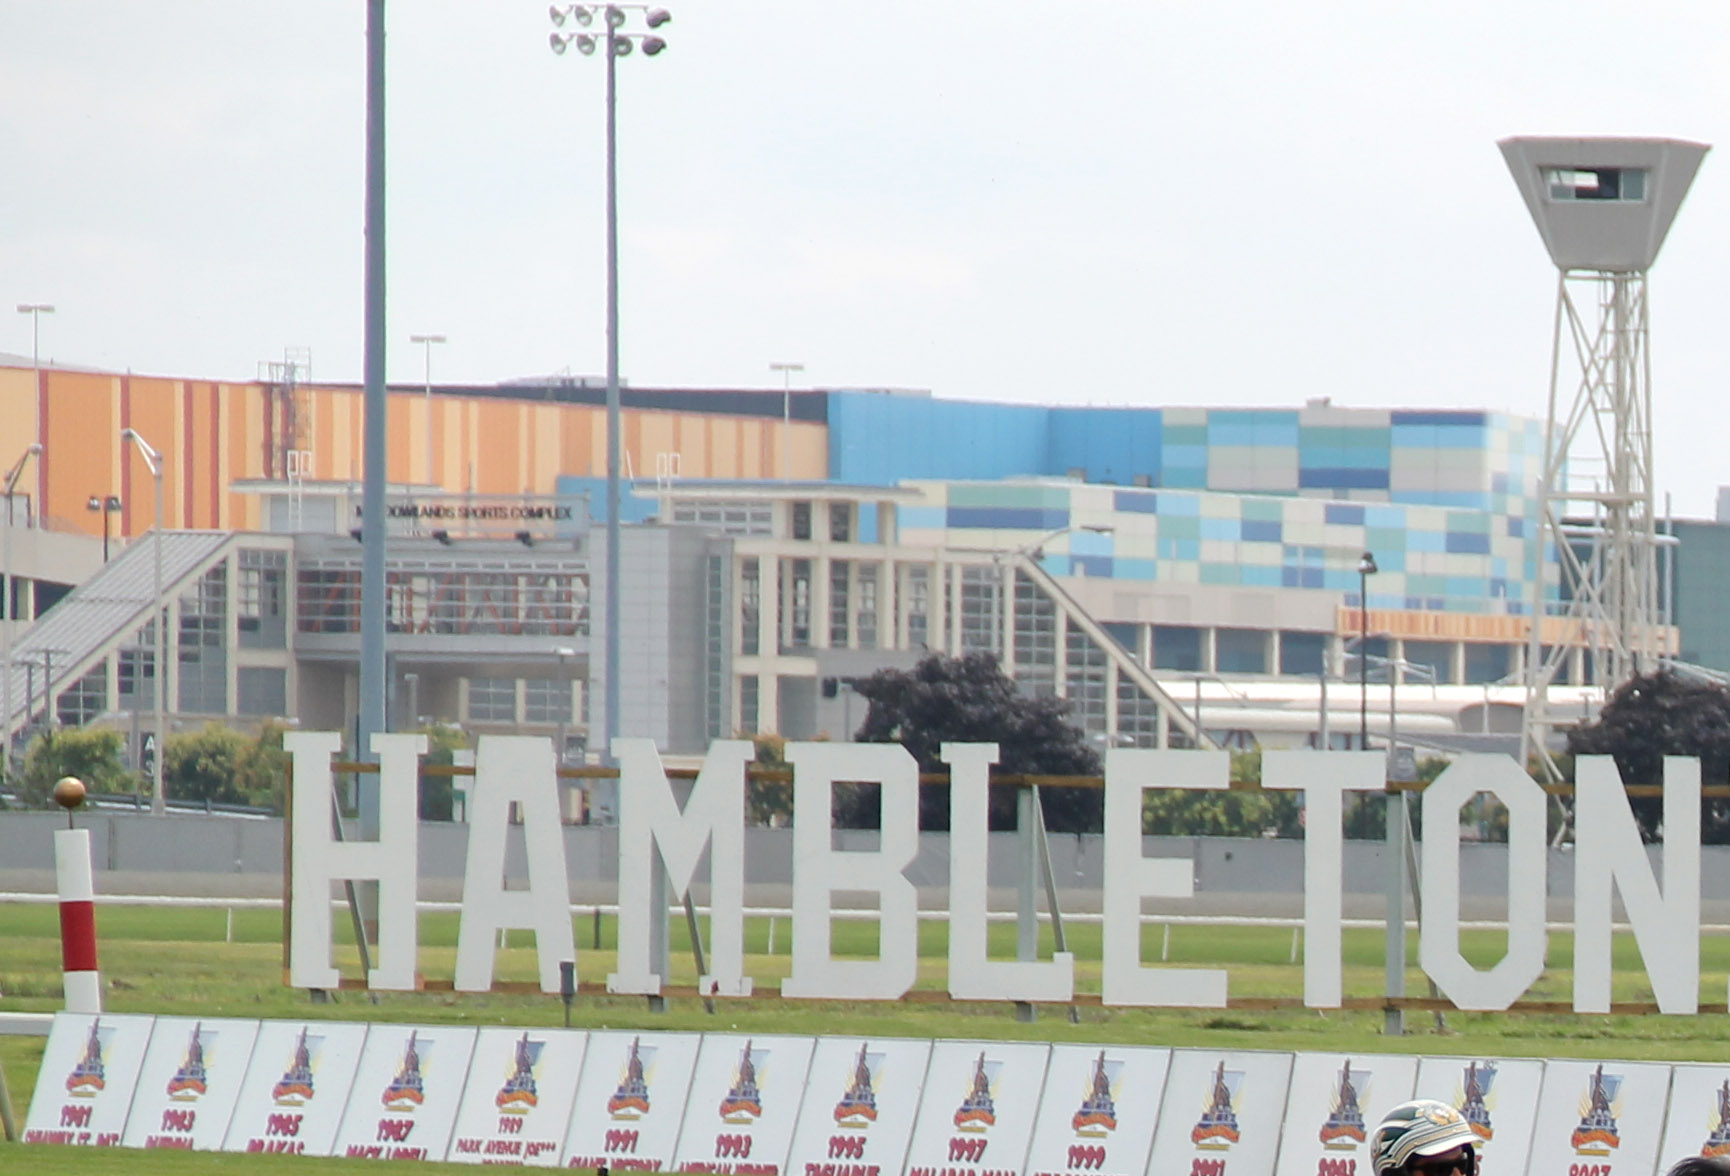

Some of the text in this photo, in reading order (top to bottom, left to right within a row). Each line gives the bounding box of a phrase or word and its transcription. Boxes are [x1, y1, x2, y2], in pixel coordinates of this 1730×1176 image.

[510, 505, 572, 519] COMPLEX
[604, 1129, 638, 1153] 1991
[715, 1134, 752, 1158] 1993
[828, 1136, 867, 1160] 1995
[949, 1137, 988, 1163] 1997
[1067, 1144, 1106, 1170] 1999
